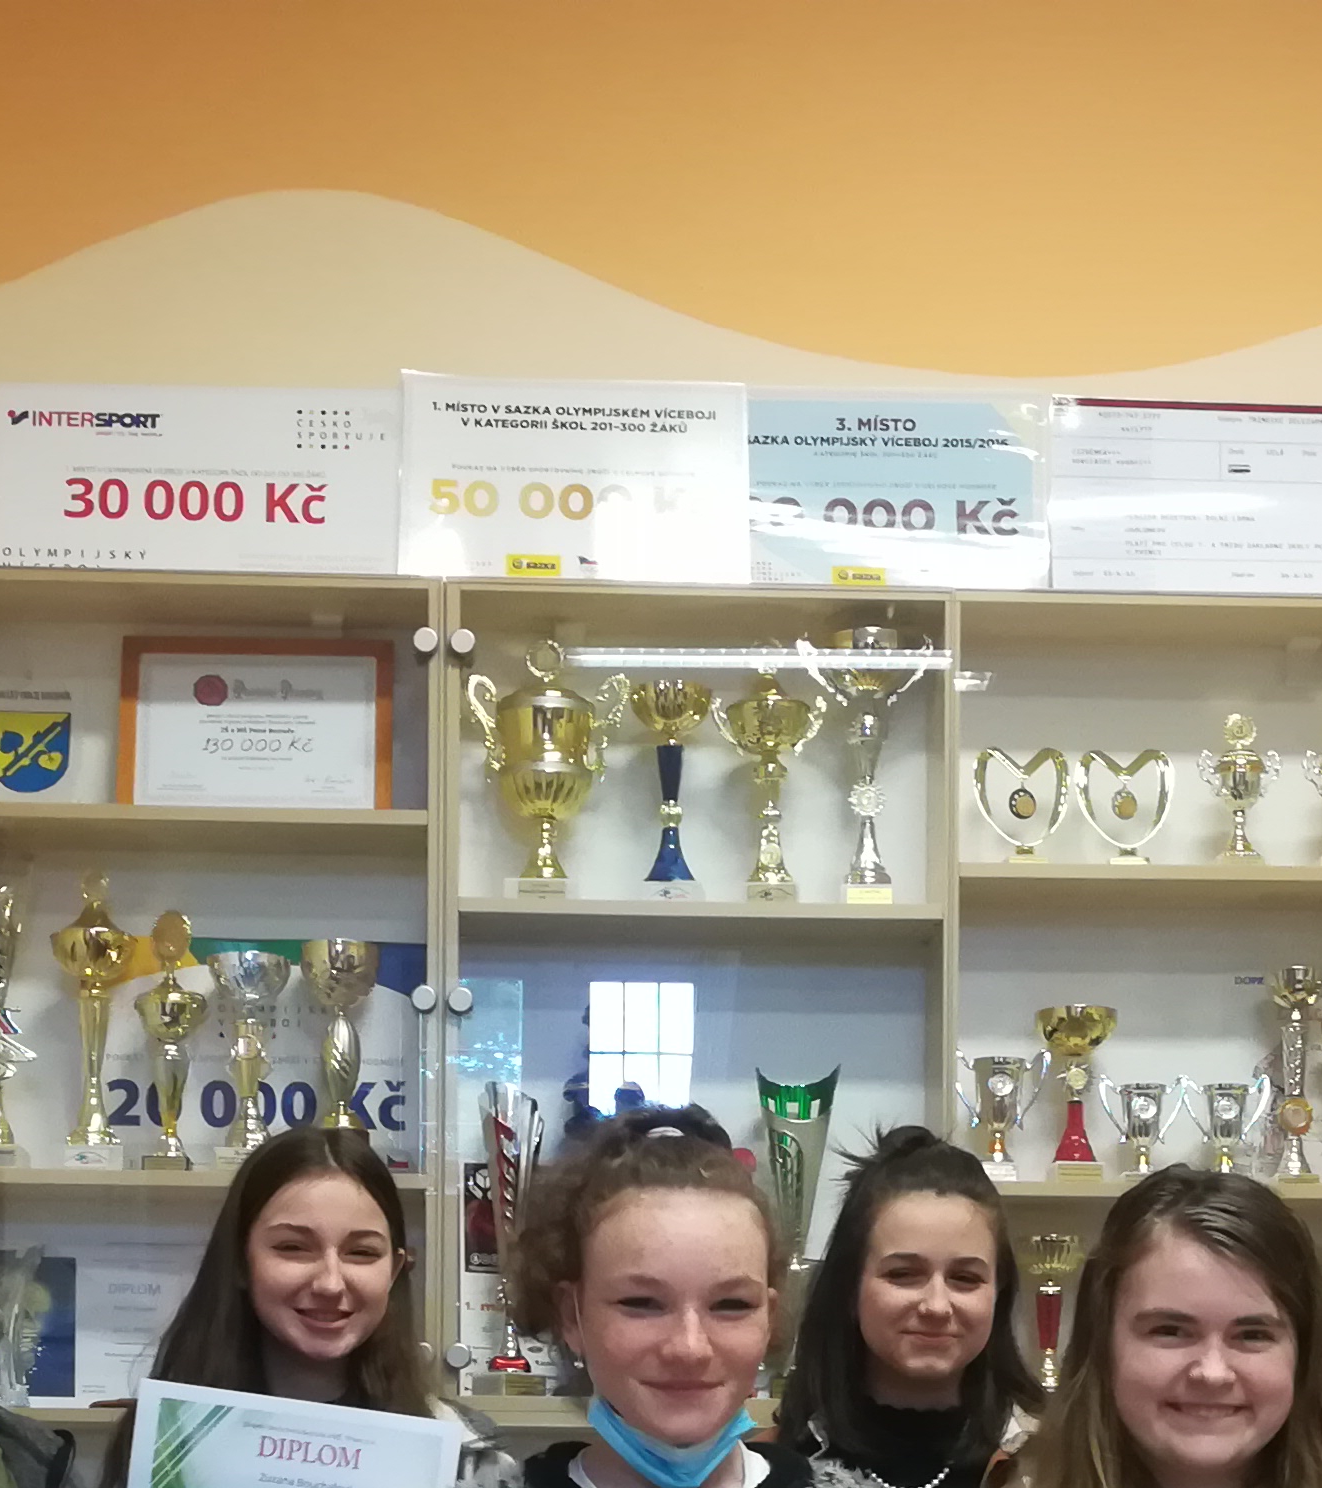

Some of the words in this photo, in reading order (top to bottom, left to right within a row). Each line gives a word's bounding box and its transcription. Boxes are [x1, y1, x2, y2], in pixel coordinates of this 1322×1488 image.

[32, 410, 161, 429] INTERSPORT
[432, 402, 441, 412] 1.
[445, 401, 488, 414] MÍSTO
[492, 405, 501, 414] V
[504, 405, 552, 416] SAZKA
[555, 405, 650, 419] OLYMPIJSKÉM
[654, 407, 717, 421] VÍCEBOJI
[461, 417, 471, 427] V
[474, 418, 548, 430] KATEGORII
[551, 418, 587, 431] ŠKOL
[649, 420, 688, 434] ŽÁKŮ
[835, 417, 852, 431] 3.
[857, 414, 917, 432] MÍSTO
[297, 431, 385, 441] SPORTUJE
[794, 434, 877, 447] OLYMPIJSKÝ
[882, 436, 939, 448] VÍCEBOJ
[63, 477, 128, 520] 30
[143, 480, 244, 523] 000
[265, 482, 328, 525] Kč
[429, 477, 499, 517] 50
[956, 497, 1020, 536] Kč
[1, 546, 146, 561] OLYMPIJSKÝ
[202, 738, 234, 754] 130
[240, 738, 282, 752] 000
[288, 736, 314, 752] Kč
[257, 1435, 362, 1470] DIPLOM
